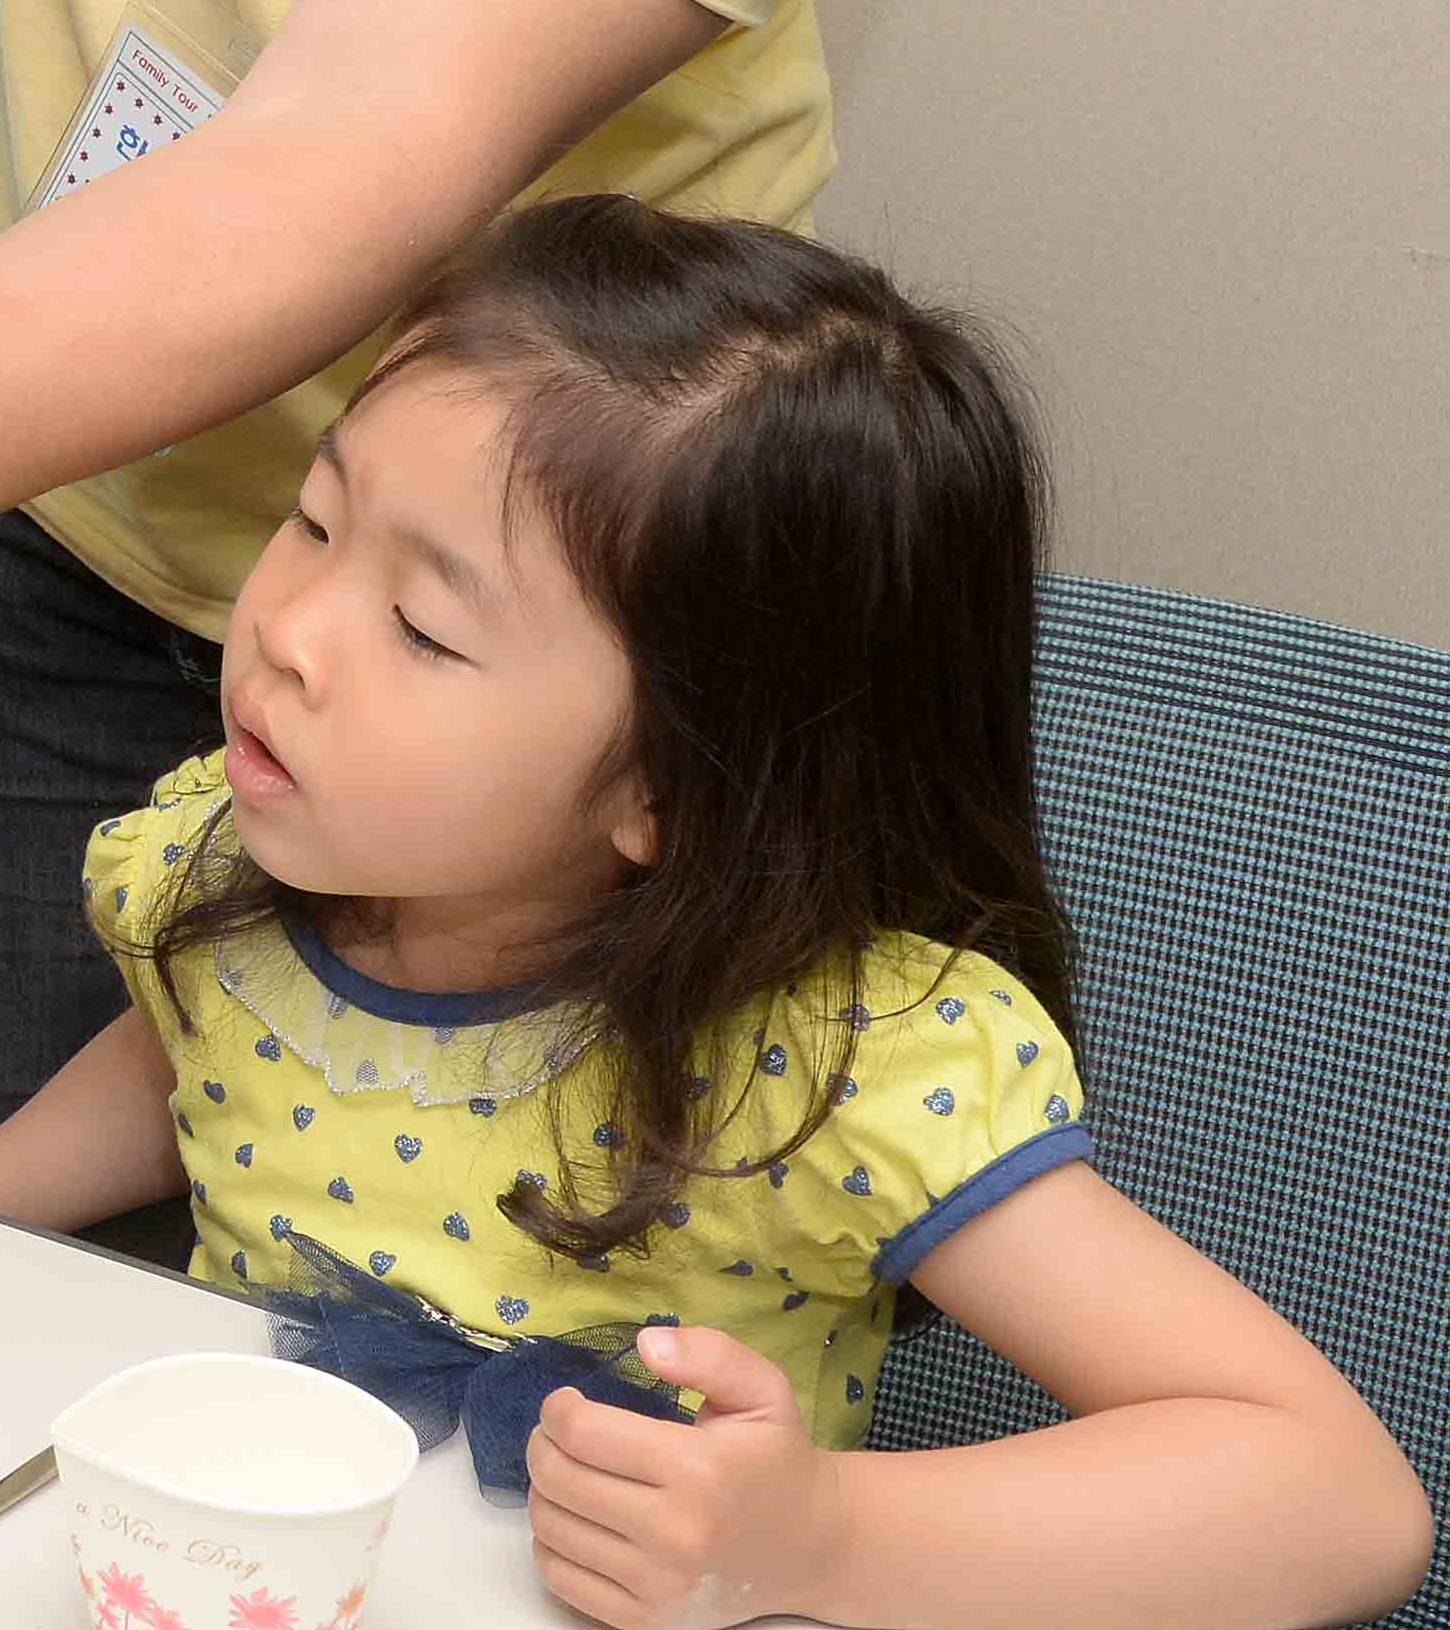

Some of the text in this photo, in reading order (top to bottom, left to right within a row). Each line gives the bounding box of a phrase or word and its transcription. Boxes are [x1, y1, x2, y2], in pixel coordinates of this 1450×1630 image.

[132, 49, 199, 113] Family Tour
[100, 1504, 171, 1553] Nice
[183, 1538, 267, 1584] Day
